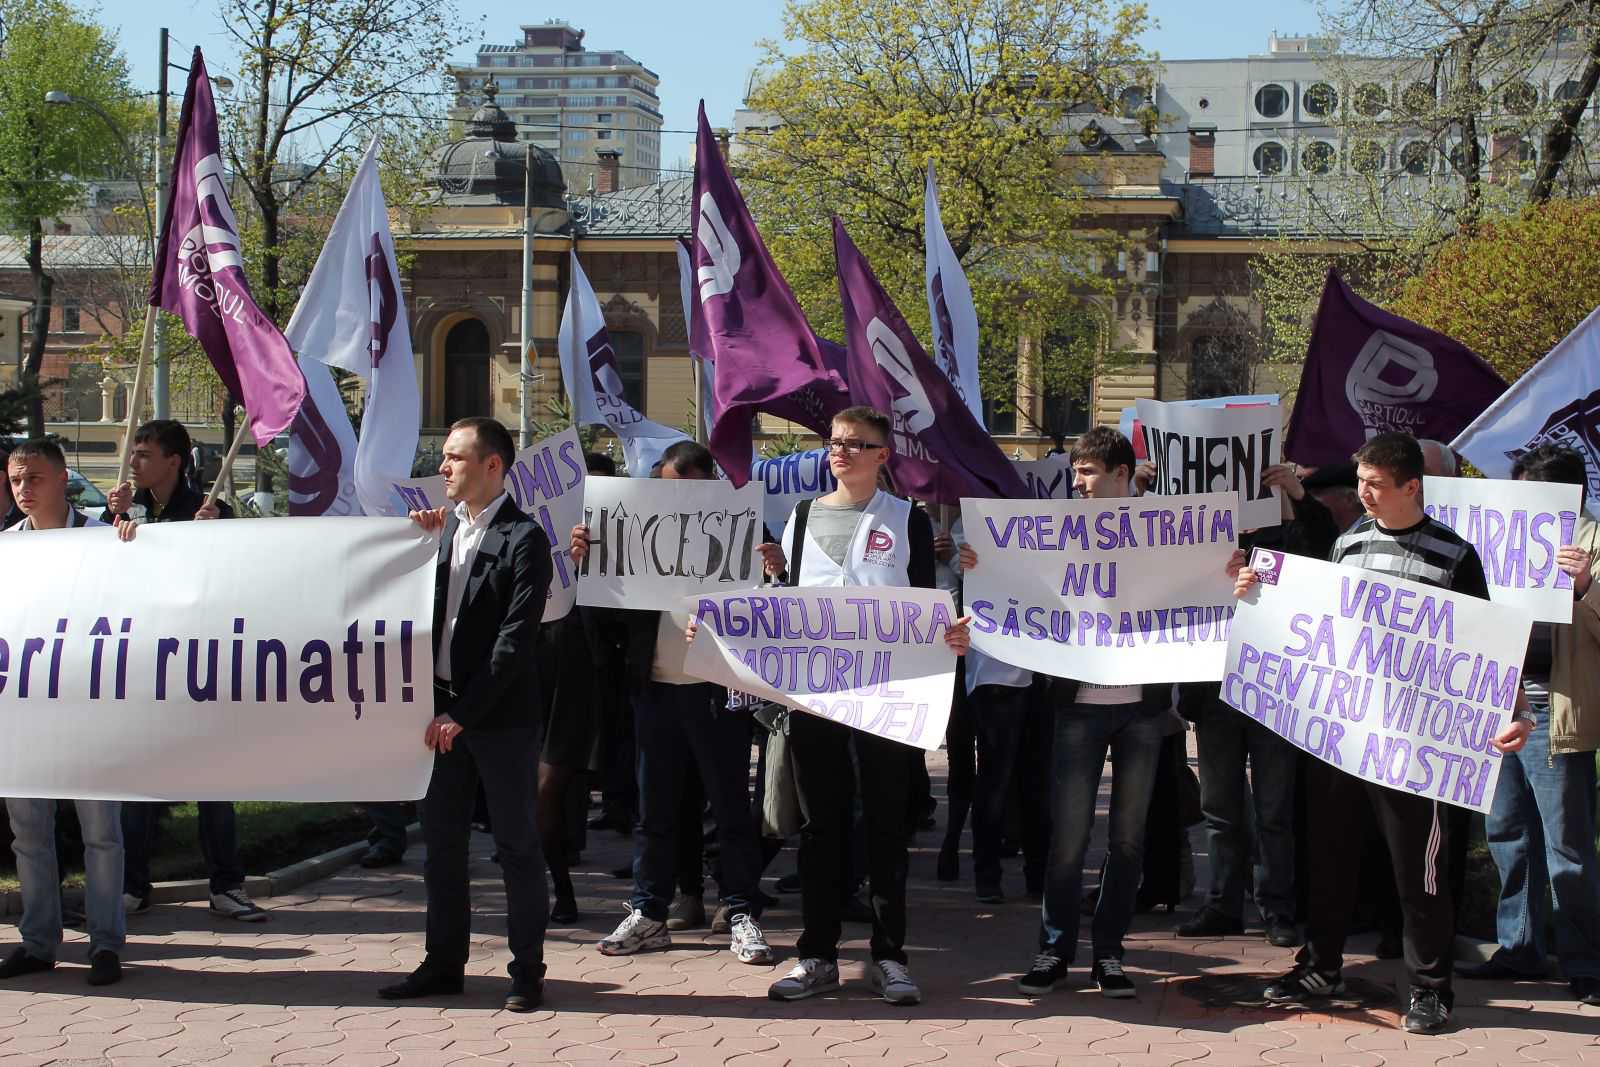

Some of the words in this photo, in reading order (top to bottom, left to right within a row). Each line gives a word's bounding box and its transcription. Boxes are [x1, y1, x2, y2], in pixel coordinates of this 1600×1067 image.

[985, 514, 1090, 551] VREM
[1060, 561, 1117, 599] NU
[1339, 576, 1454, 644] VREM
[694, 596, 953, 644] AGRICULTURA
[88, 617, 132, 699] îi
[155, 617, 414, 720] ruinați!
[1284, 612, 1337, 665] SĂ
[1347, 625, 1519, 711] MUNCIM
[1237, 642, 1373, 722] PENTRU
[1383, 681, 1503, 758] VIITORUL
[1358, 732, 1493, 807] NOȘTRI
